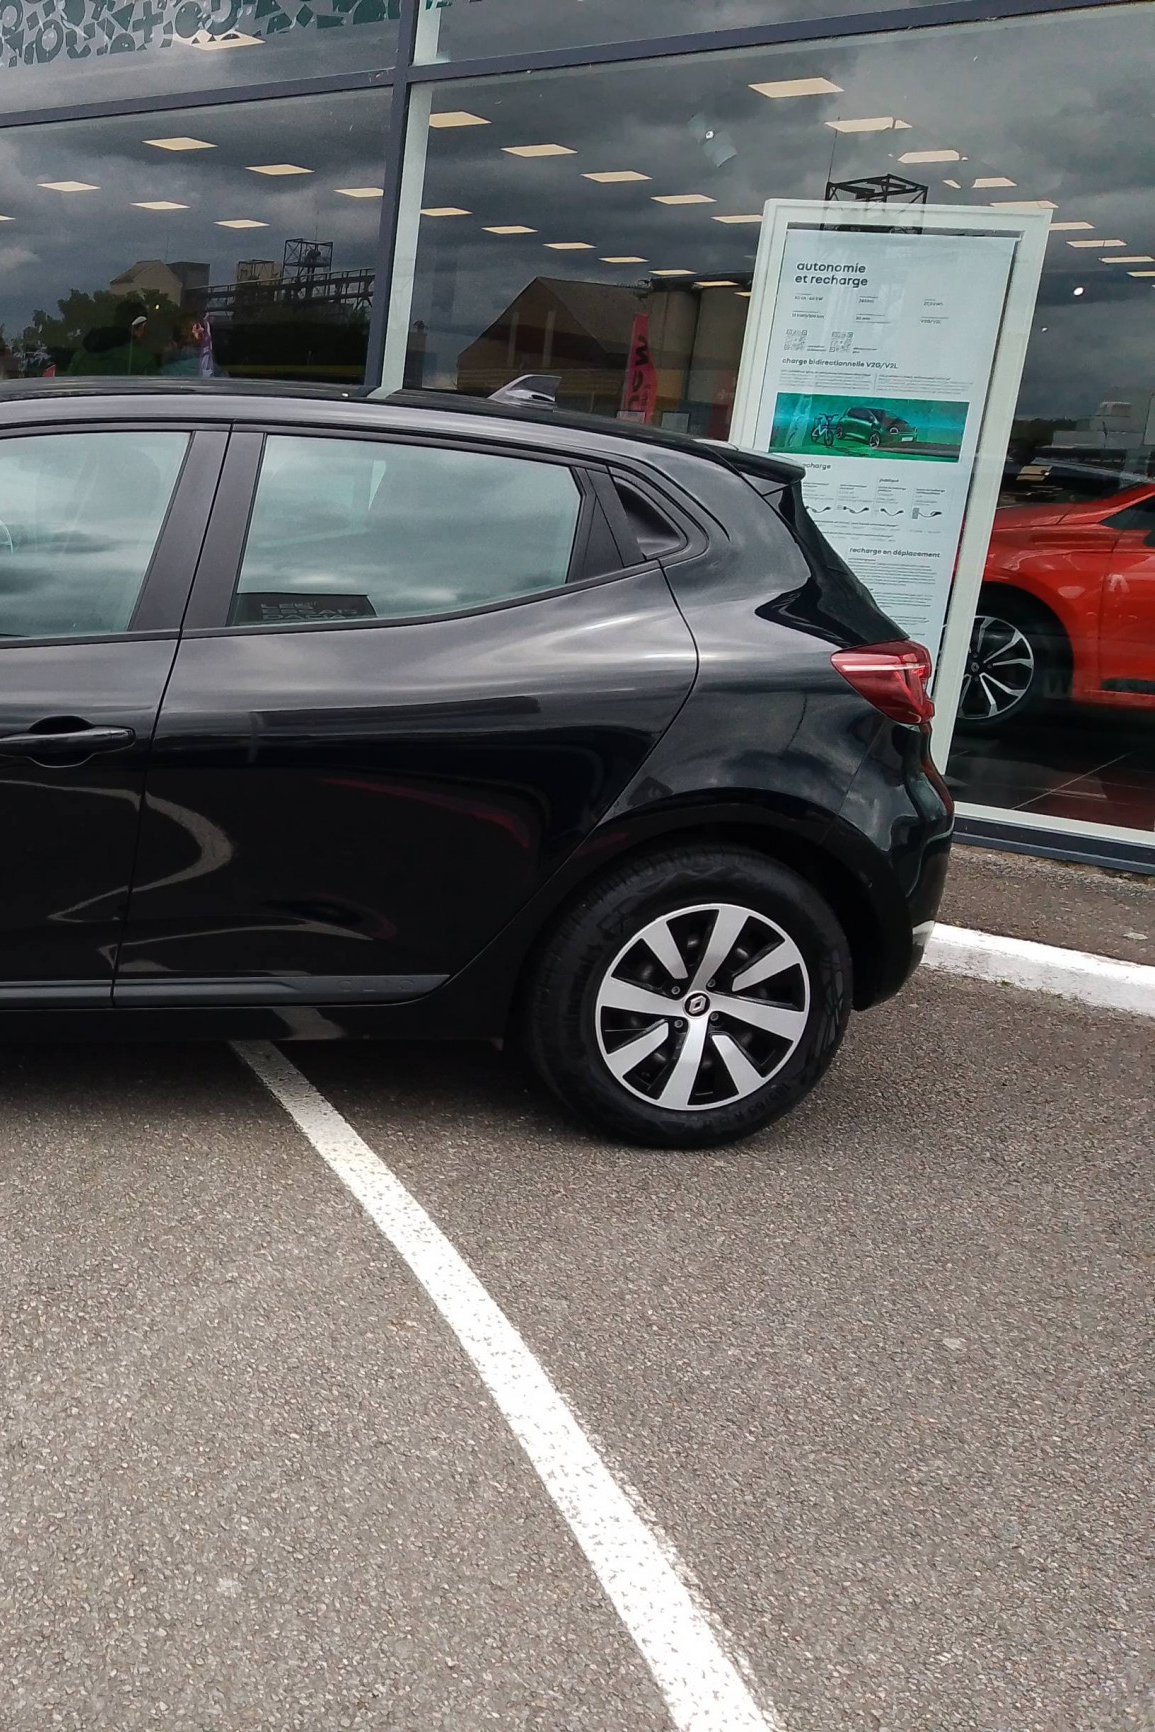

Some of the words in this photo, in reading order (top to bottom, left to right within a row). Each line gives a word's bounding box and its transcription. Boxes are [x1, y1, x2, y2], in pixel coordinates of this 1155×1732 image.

[796, 262, 866, 273] autonomie
[795, 275, 808, 283] et
[810, 274, 868, 288] recharge
[782, 357, 807, 366] charge
[808, 358, 865, 368] bidirectionnelle
[849, 547, 882, 556] recharge
[892, 549, 941, 558] déplacement
